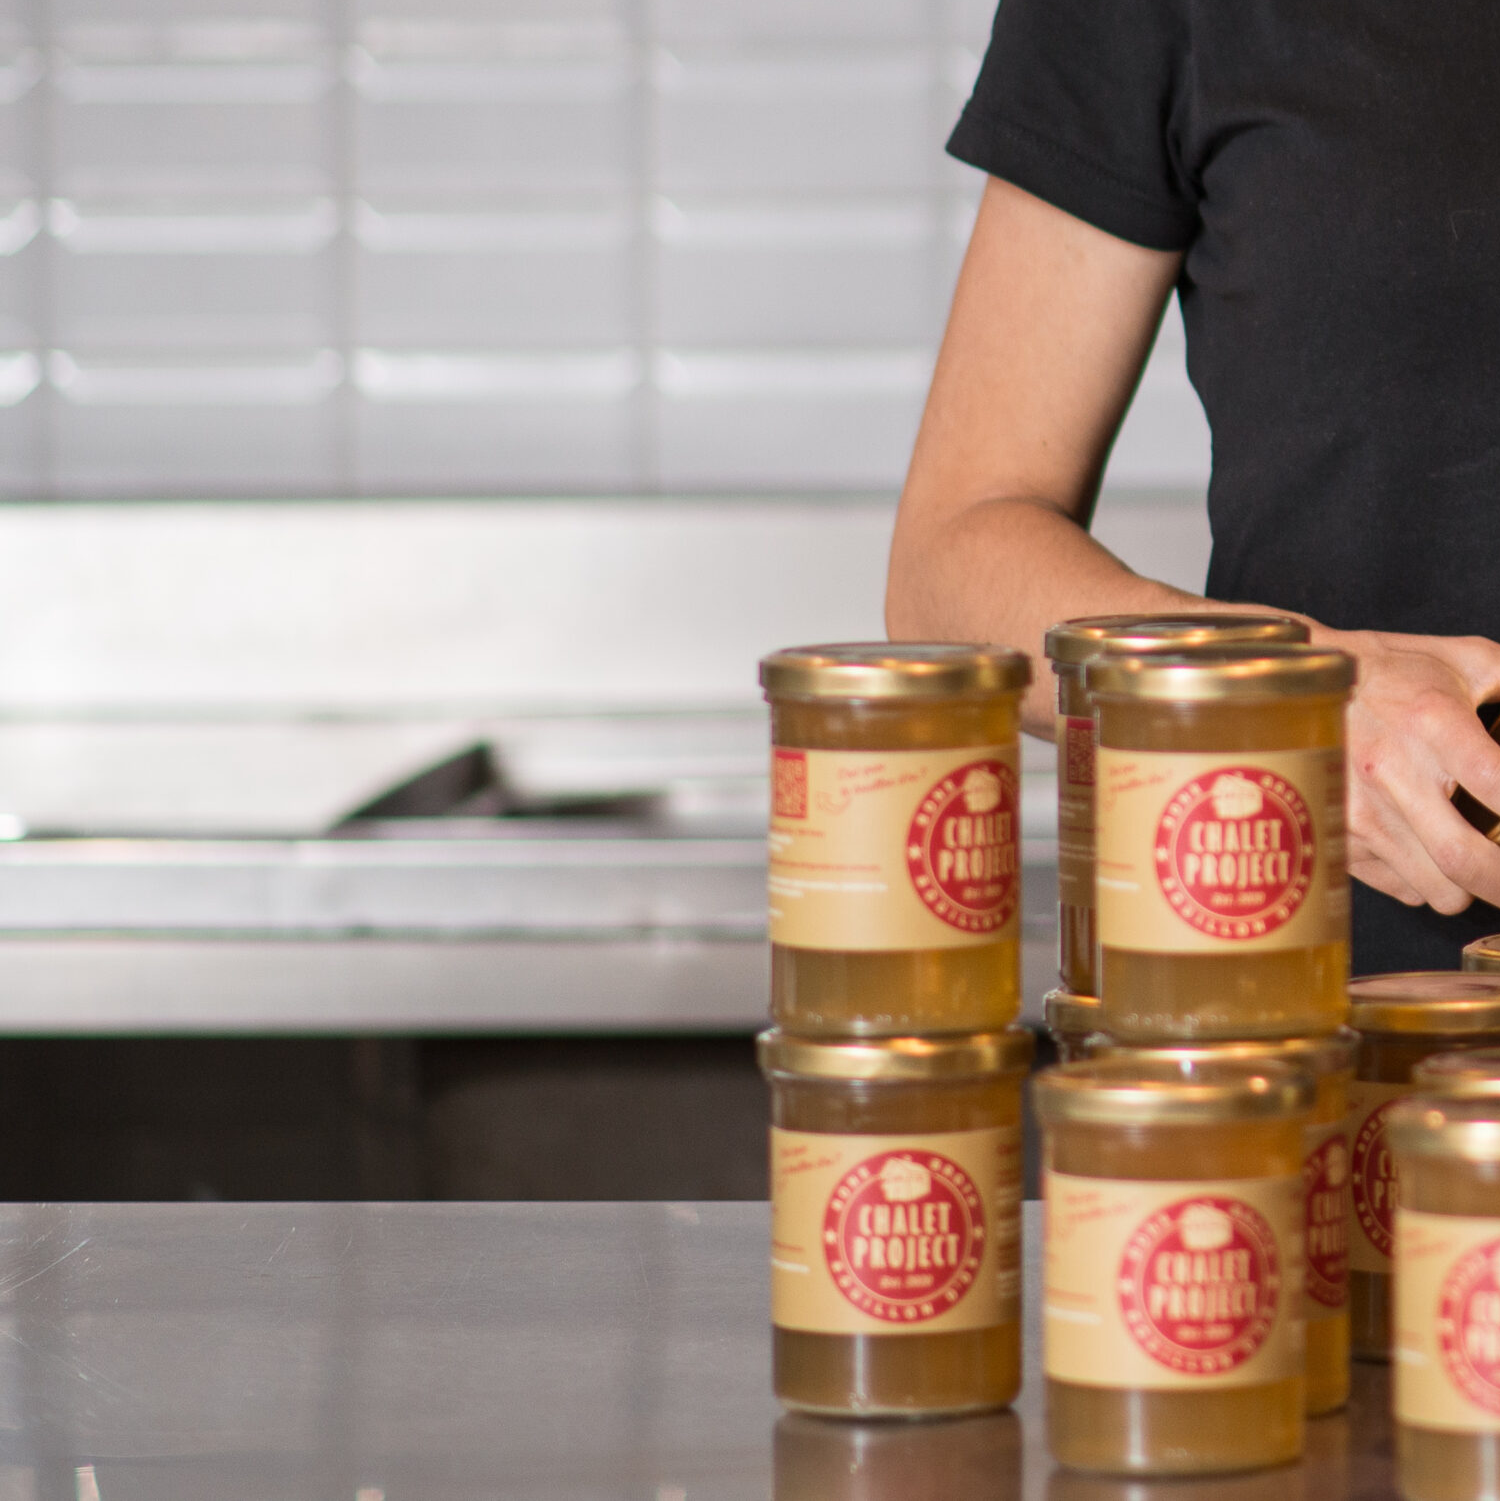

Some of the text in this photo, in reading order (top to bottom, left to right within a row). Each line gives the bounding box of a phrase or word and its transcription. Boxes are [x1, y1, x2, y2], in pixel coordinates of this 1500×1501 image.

[1190, 819, 1282, 852] CHALET
[1184, 851, 1290, 889] PROJECT
[858, 1201, 952, 1236] CHALET
[852, 1233, 959, 1271] PROJECT
